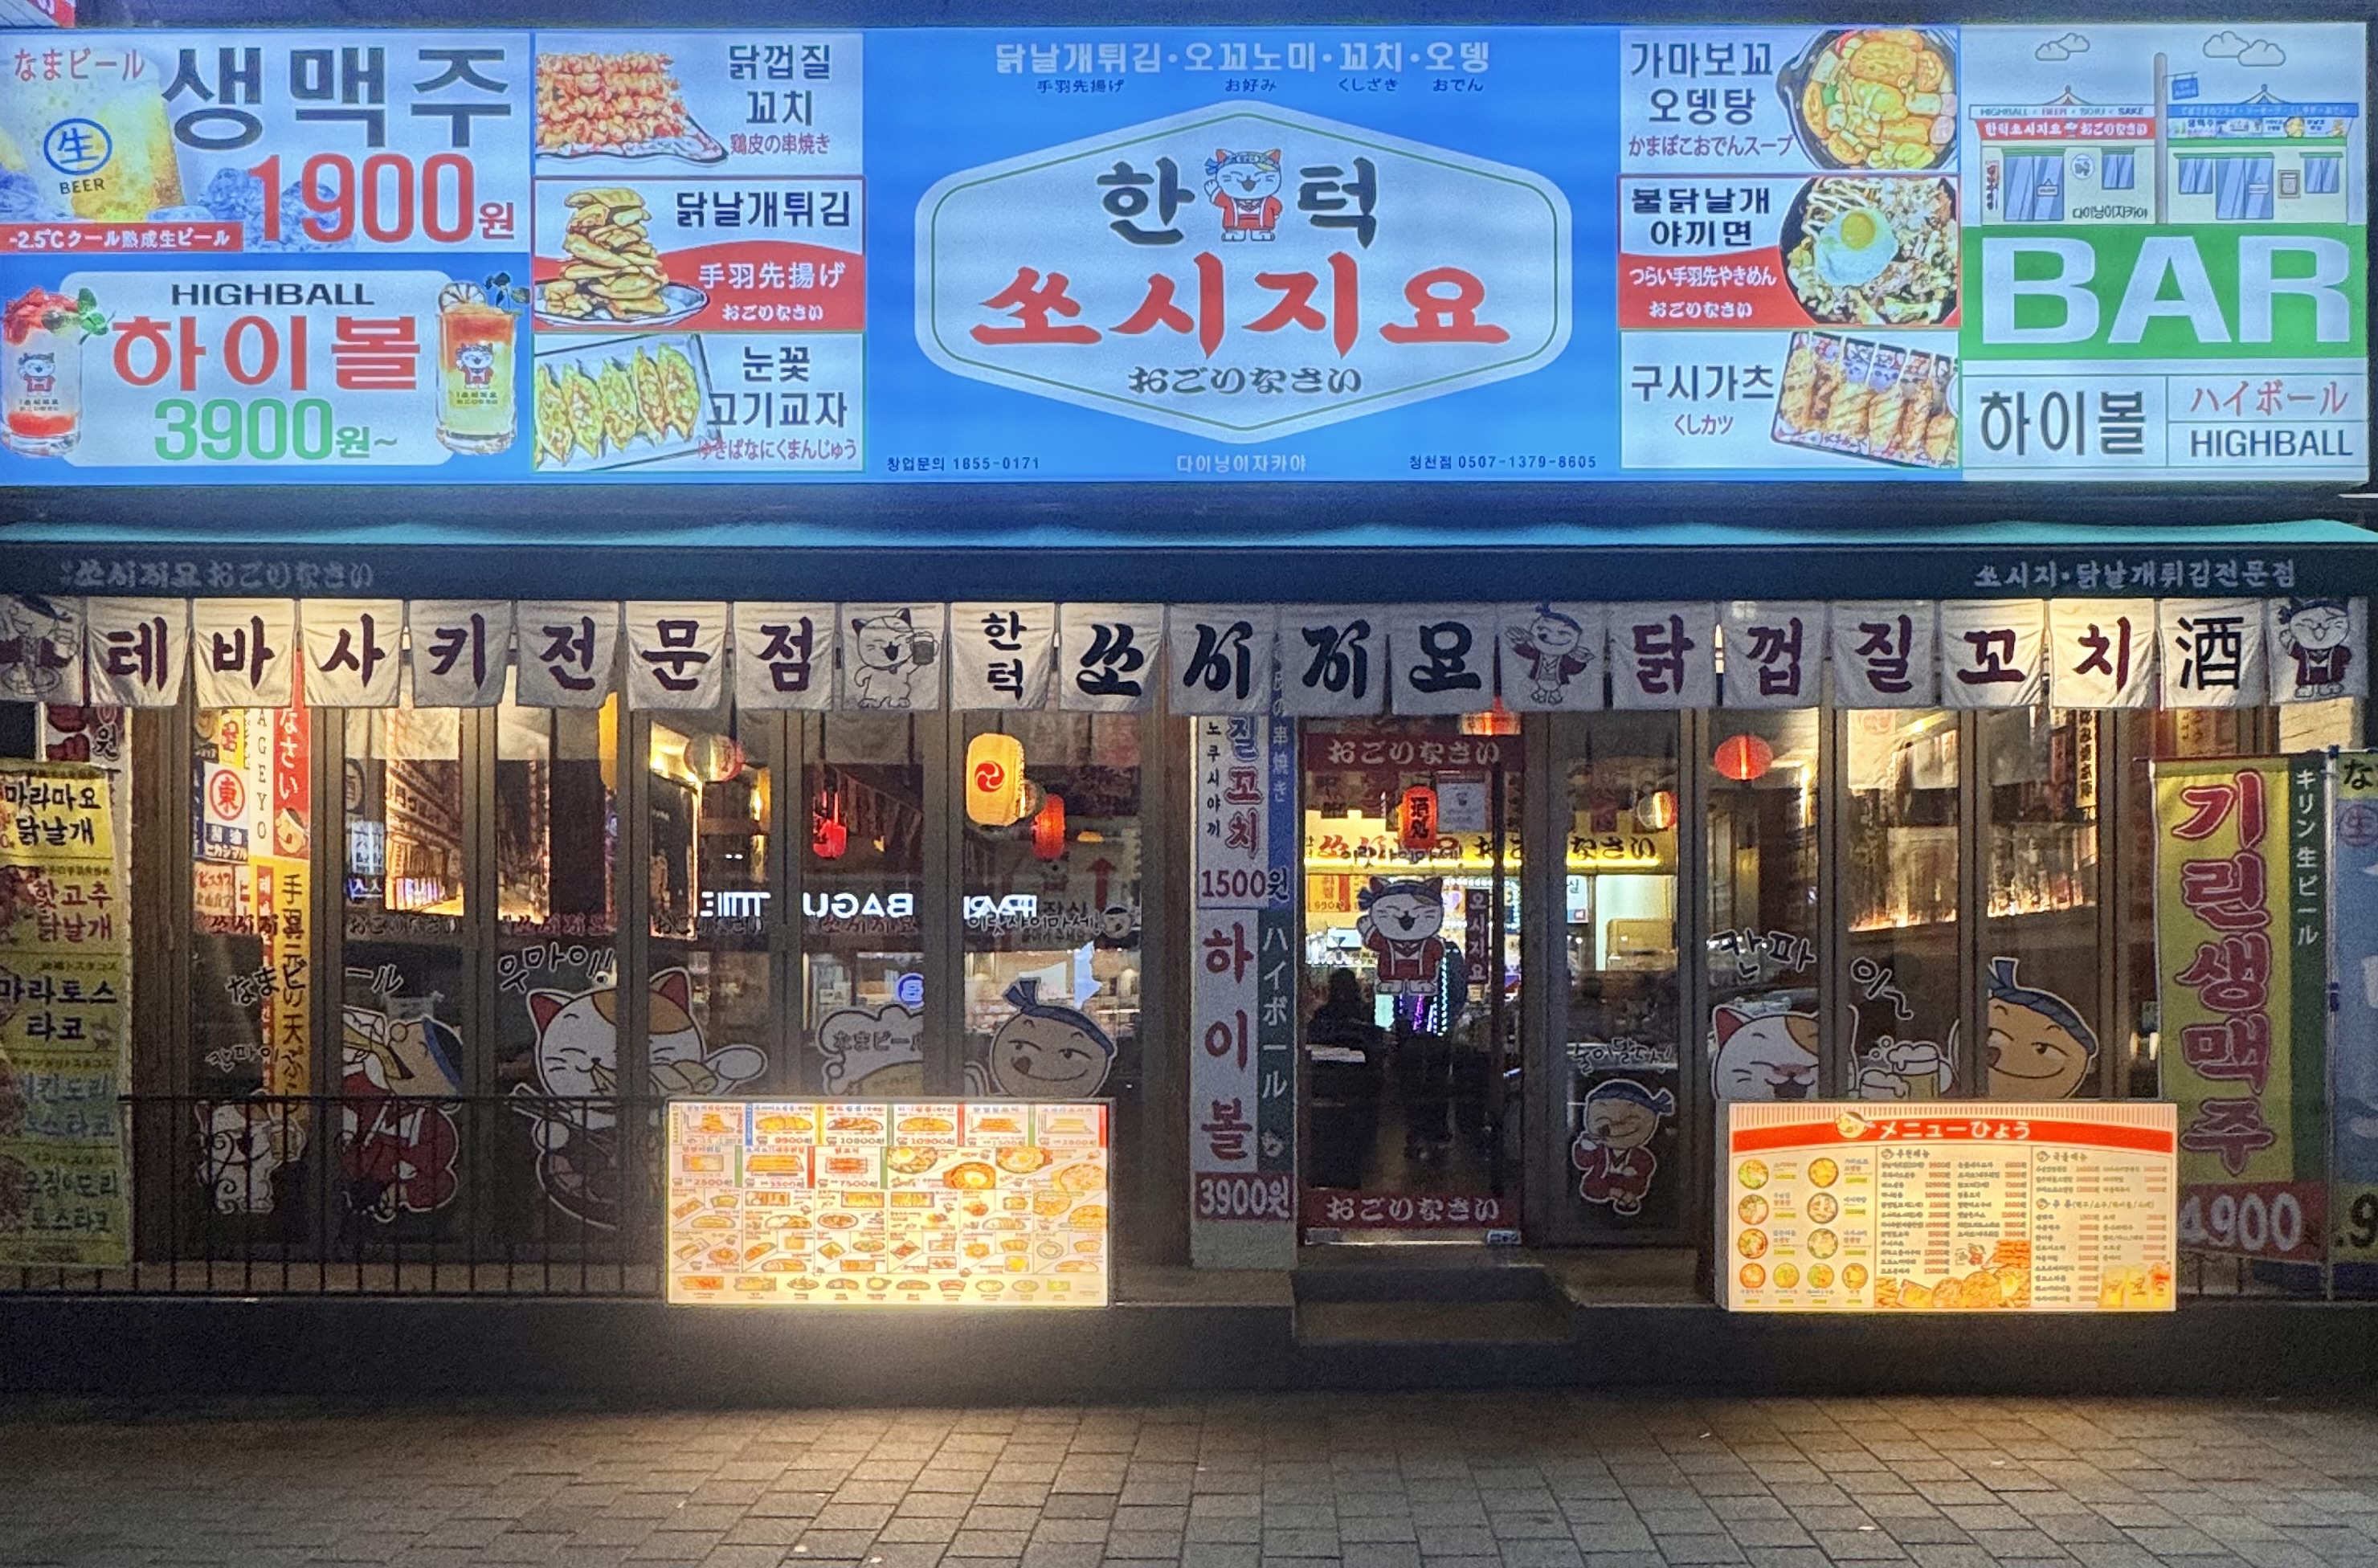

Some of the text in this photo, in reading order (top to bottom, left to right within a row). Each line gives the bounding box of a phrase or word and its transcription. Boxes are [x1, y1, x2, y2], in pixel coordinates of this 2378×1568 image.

[14, 48, 145, 82] なまビール
[729, 44, 831, 80] 닭껍질
[995, 41, 1489, 73] 닭날개튀김 오꼬노미 꼬치 오뎅
[1630, 43, 1774, 79] 가마보꼬
[161, 46, 512, 150] 생맥주
[1036, 77, 1125, 94] 手羽先揚げ
[1224, 77, 1277, 93] お好み
[1432, 77, 1484, 93] おでん
[746, 89, 813, 127] 꼬치
[1649, 88, 1756, 126] 오뎅탕
[57, 127, 97, 164] 生
[59, 178, 106, 195] BEER
[249, 153, 515, 243] 1900원
[1632, 188, 1771, 214] 불닭날개
[676, 191, 850, 227] 닭날개튀김
[2072, 205, 2148, 219] 다이닝이자카야
[1650, 220, 1752, 247] 야끼면
[699, 262, 845, 289] 手羽先揚げ
[1629, 265, 1777, 288] つらい手羽先やきめん
[1982, 235, 2351, 344] BAR
[170, 283, 375, 306] HIGHBALL
[969, 251, 1510, 359] 쏘시지요
[112, 314, 422, 391] 하이볼
[742, 346, 810, 382] 눈꽃
[1127, 366, 1363, 395] おごりなさい
[1631, 365, 1775, 402] 구시가츠
[2189, 379, 2349, 417] ハイボール
[707, 391, 848, 429] 고기교자
[1673, 414, 1734, 437] くしカツ
[1980, 390, 2147, 456] 하이볼
[2190, 429, 2354, 458] HIGHBALL
[886, 455, 1040, 472] 창업문의 1855-0171
[1176, 454, 1308, 472] 다이닝이자카야
[1457, 455, 1598, 469] 0507-1379-8605
[980, 610, 1025, 701] 한턱
[2175, 615, 2245, 691] 酒
[5, 780, 102, 813] 마라마요
[216, 775, 243, 815] 東
[15, 815, 95, 847] 닭날개
[2295, 768, 2320, 947] キリン生ビール
[1201, 867, 1290, 902] 1500원
[37, 913, 113, 943] 닭날개
[2171, 768, 2276, 1177] 기린생맥주
[1261, 926, 1289, 1100] ハイボール
[1201, 921, 1255, 1162] 하이볼
[1878, 1121, 2031, 1140] メニューひょう
[1200, 1177, 1289, 1219] 3900원
